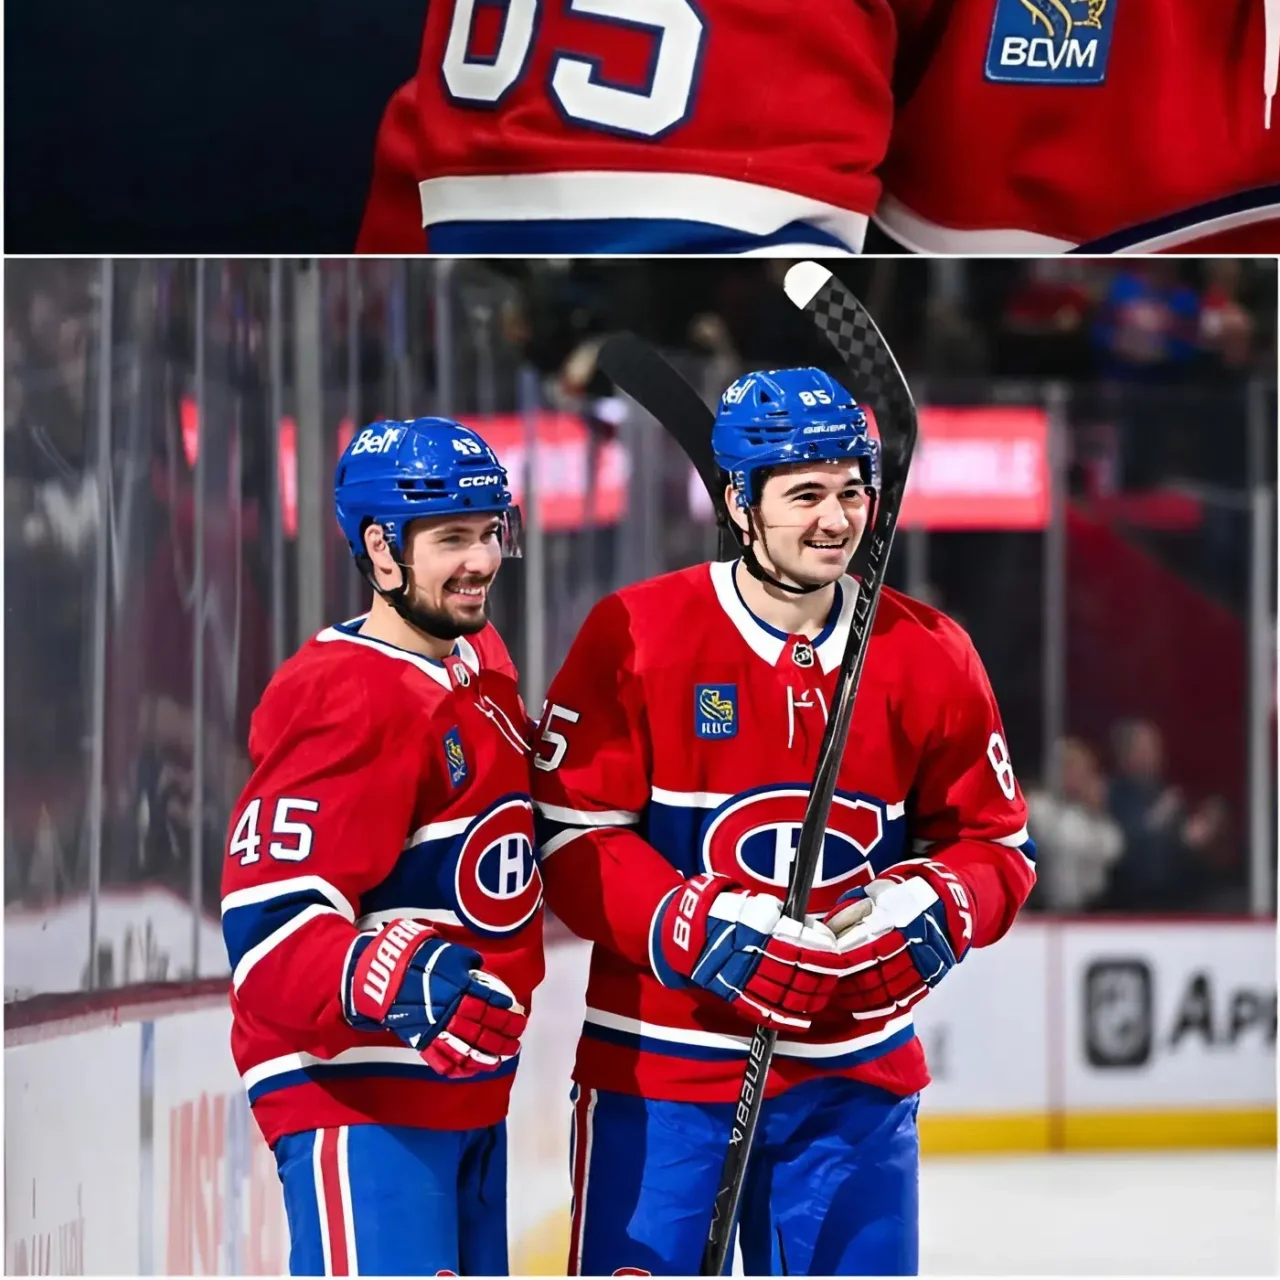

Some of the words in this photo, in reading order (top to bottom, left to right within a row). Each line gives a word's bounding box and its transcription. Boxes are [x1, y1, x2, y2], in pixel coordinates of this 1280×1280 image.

[798, 389, 832, 407] 85
[452, 437, 482, 456] 45
[459, 475, 498, 488] CCM
[534, 699, 580, 772] 5
[229, 797, 320, 866] 45
